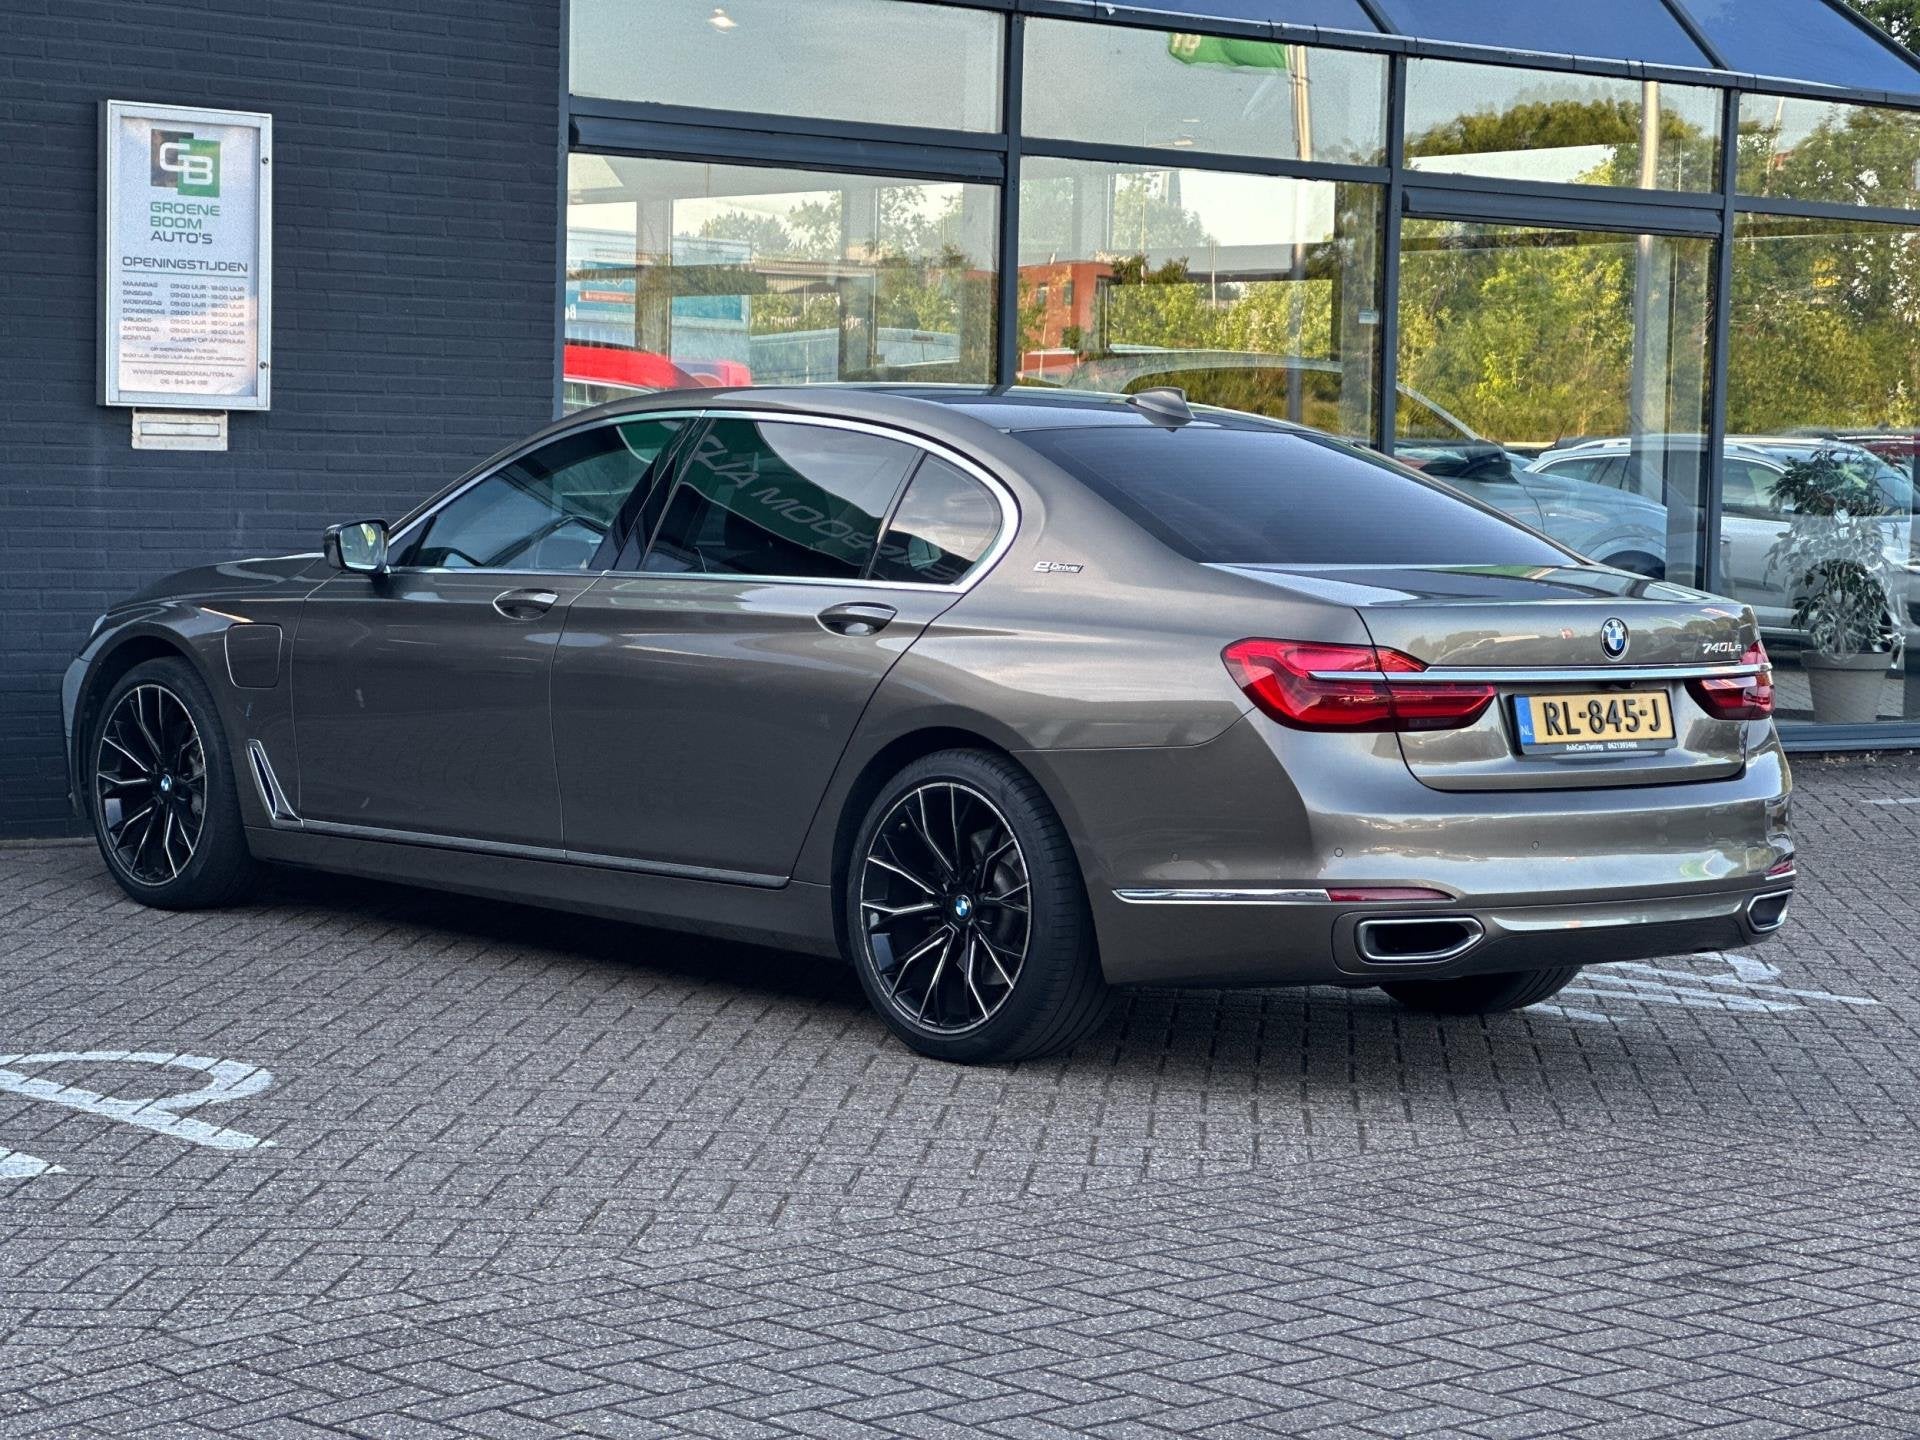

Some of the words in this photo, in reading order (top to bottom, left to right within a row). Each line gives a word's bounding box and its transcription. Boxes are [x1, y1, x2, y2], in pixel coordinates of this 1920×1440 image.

[150, 202, 220, 216] GROENE
[150, 216, 202, 230] BOOM
[150, 231, 213, 245] AUTO'S
[122, 256, 248, 273] OPENINGSTIJDEN
[1702, 642, 1742, 654] 740Le
[1543, 699, 1661, 736] RL-845-J
[1520, 725, 1533, 736] NL
